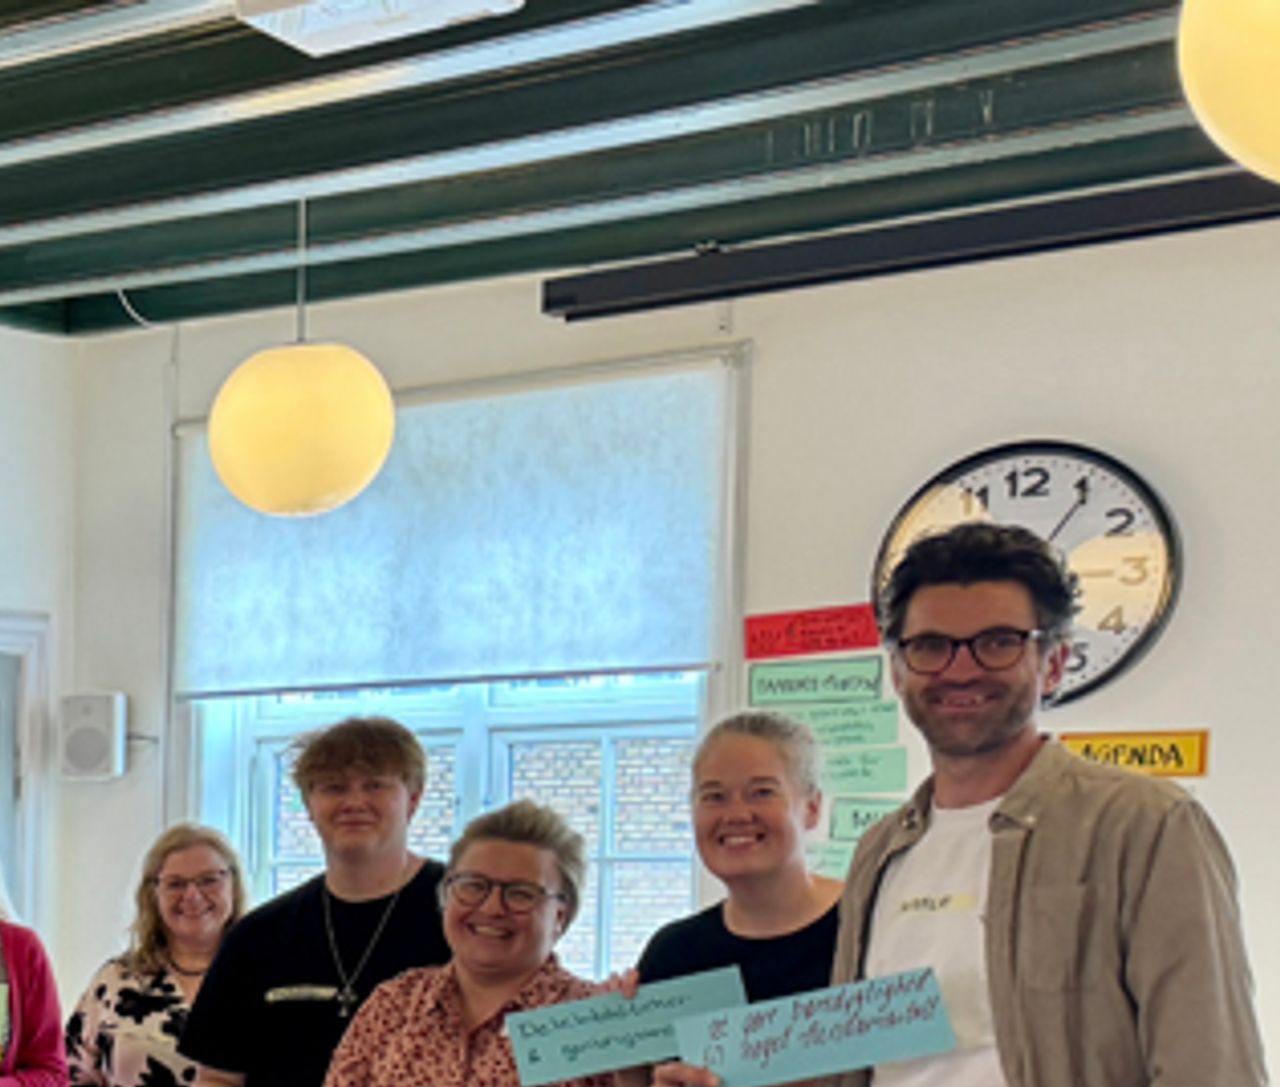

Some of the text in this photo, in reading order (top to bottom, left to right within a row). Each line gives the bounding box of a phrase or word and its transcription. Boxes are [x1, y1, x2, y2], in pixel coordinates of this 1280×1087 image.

[1004, 467, 1051, 498] 12
[1073, 477, 1088, 505] 1
[1105, 508, 1136, 537] 2
[1119, 556, 1150, 586] 3
[1097, 605, 1128, 635] 4
[1081, 743, 1184, 769] AGENDA
